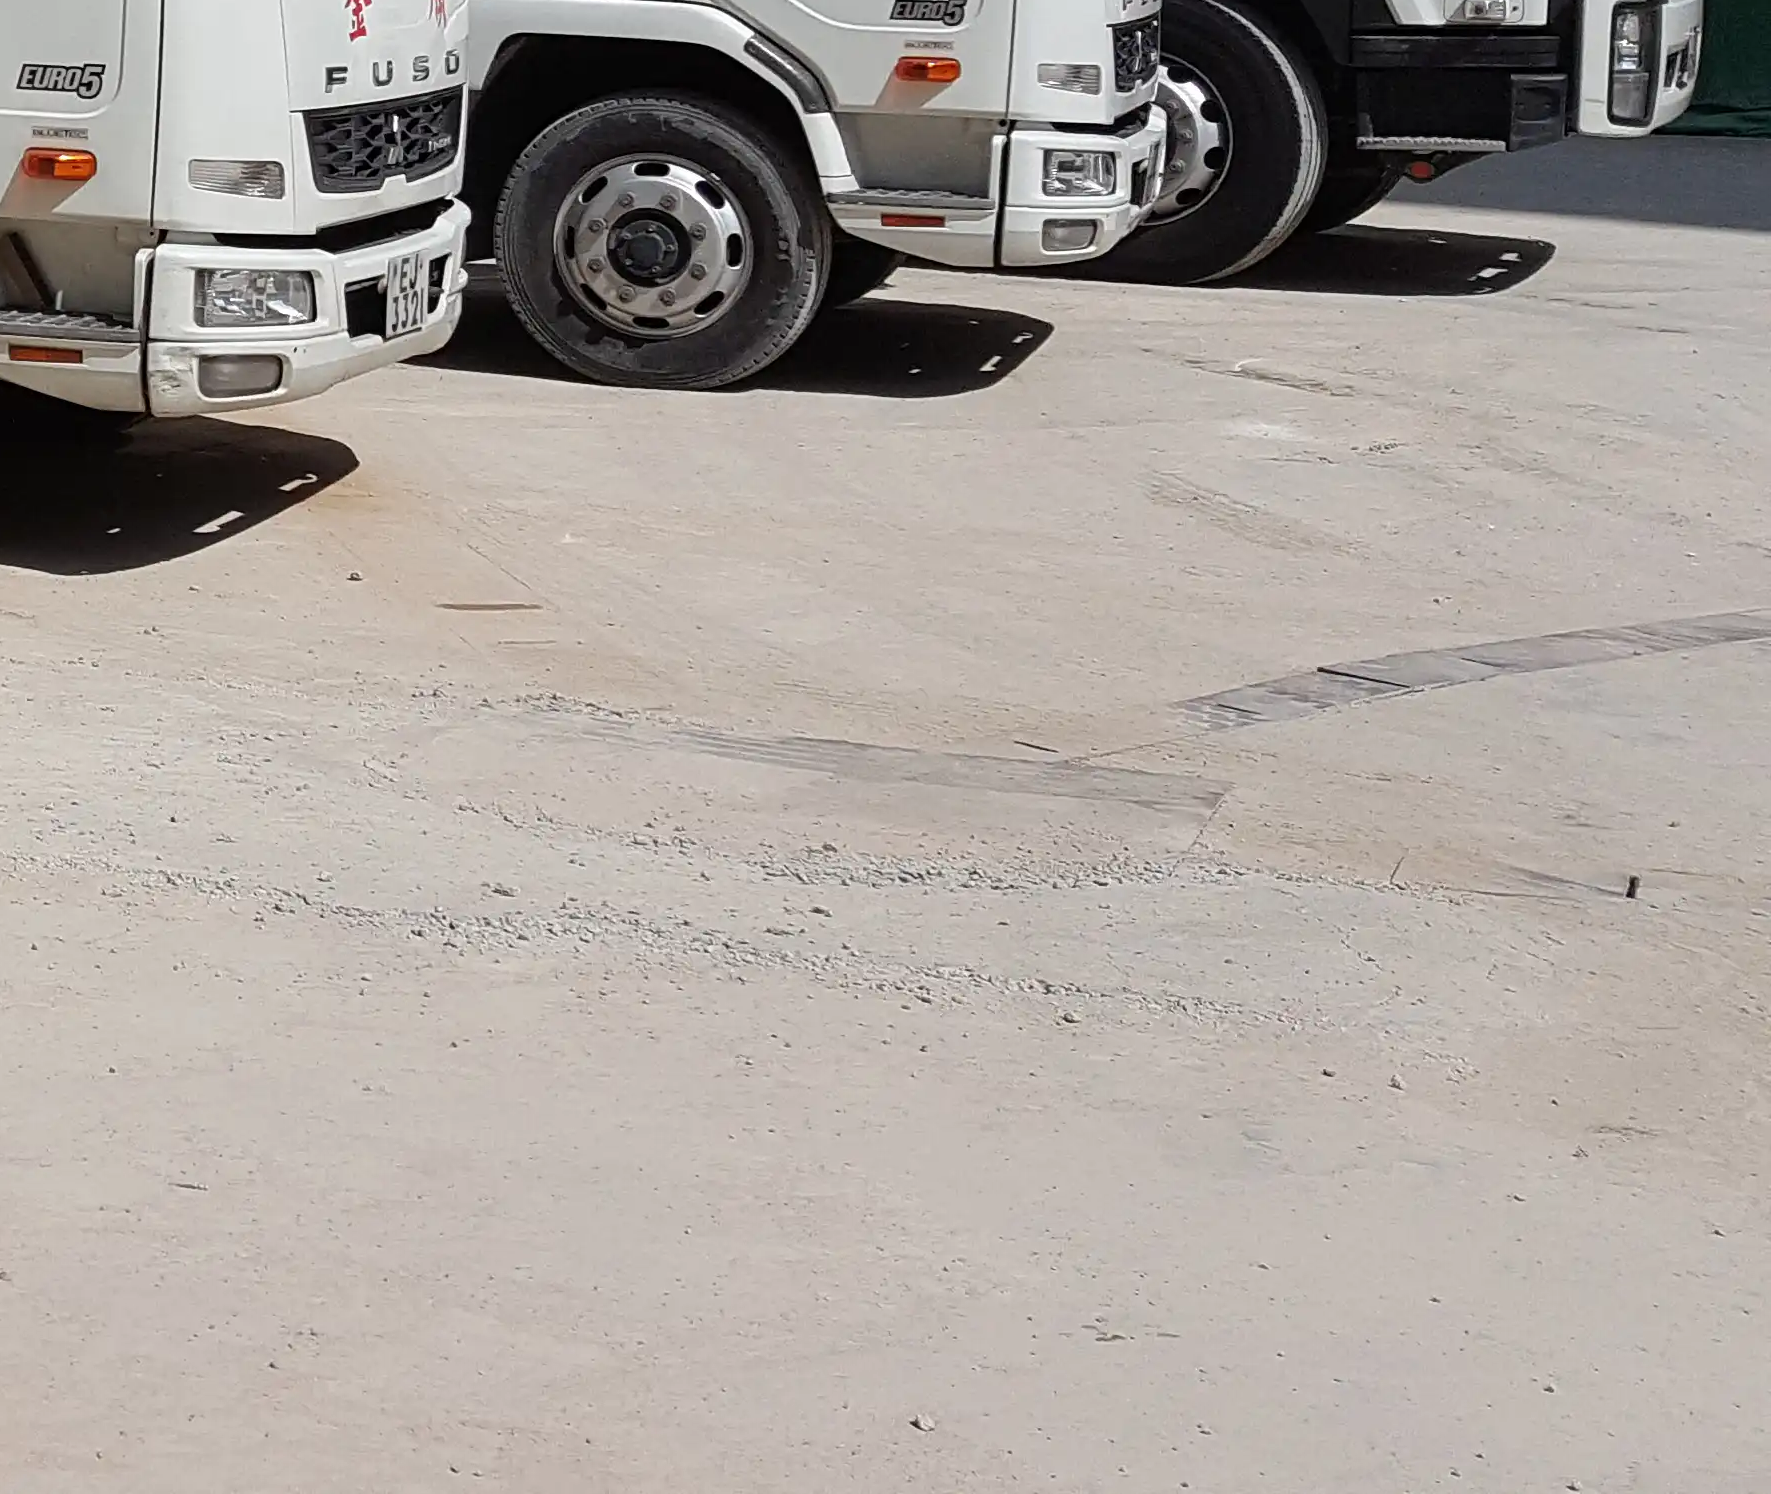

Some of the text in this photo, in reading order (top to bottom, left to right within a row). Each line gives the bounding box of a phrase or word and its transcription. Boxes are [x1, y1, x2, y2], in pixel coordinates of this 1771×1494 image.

[17, 63, 106, 99] EURO5
[324, 48, 460, 94] FUSO
[399, 253, 419, 293] EJ
[392, 287, 424, 332] 3321
